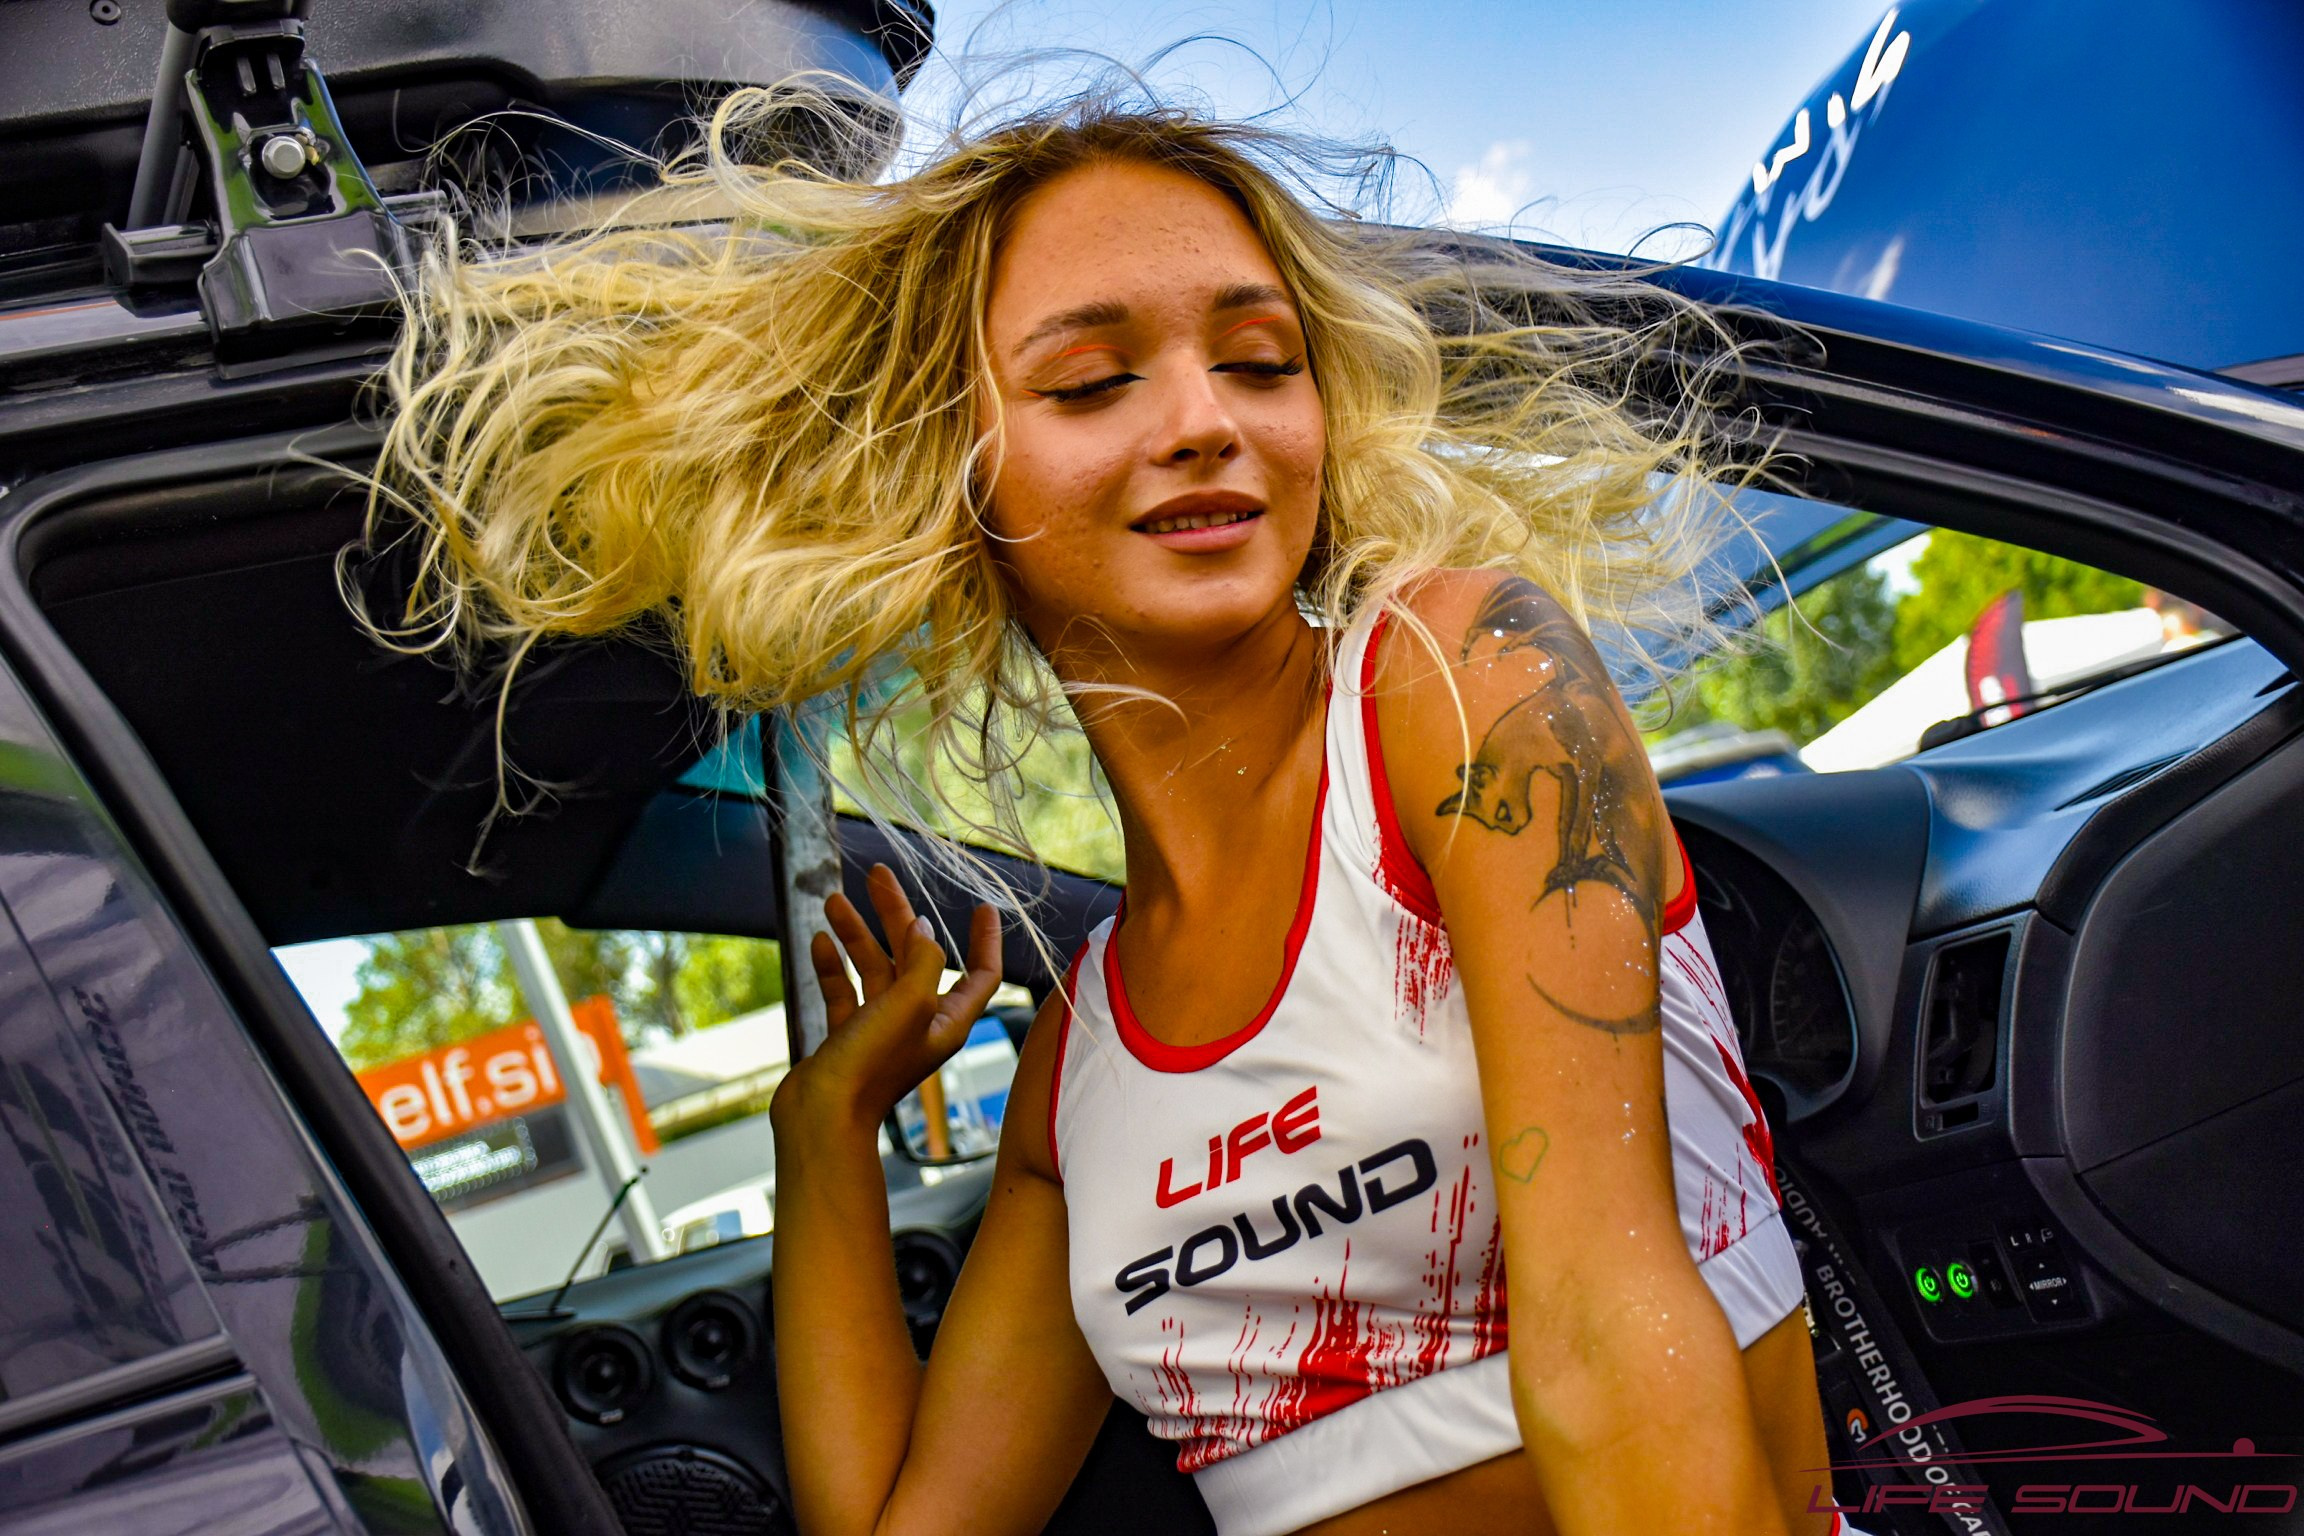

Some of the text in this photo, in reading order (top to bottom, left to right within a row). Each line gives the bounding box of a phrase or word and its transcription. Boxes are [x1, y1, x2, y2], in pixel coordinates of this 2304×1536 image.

[1155, 1085, 1322, 1209] LIFE
[1115, 1138, 1438, 1316] SOUND
[2033, 1277, 2064, 1290] MIRROR
[1816, 1264, 1933, 1464] BROTHERHOOD
